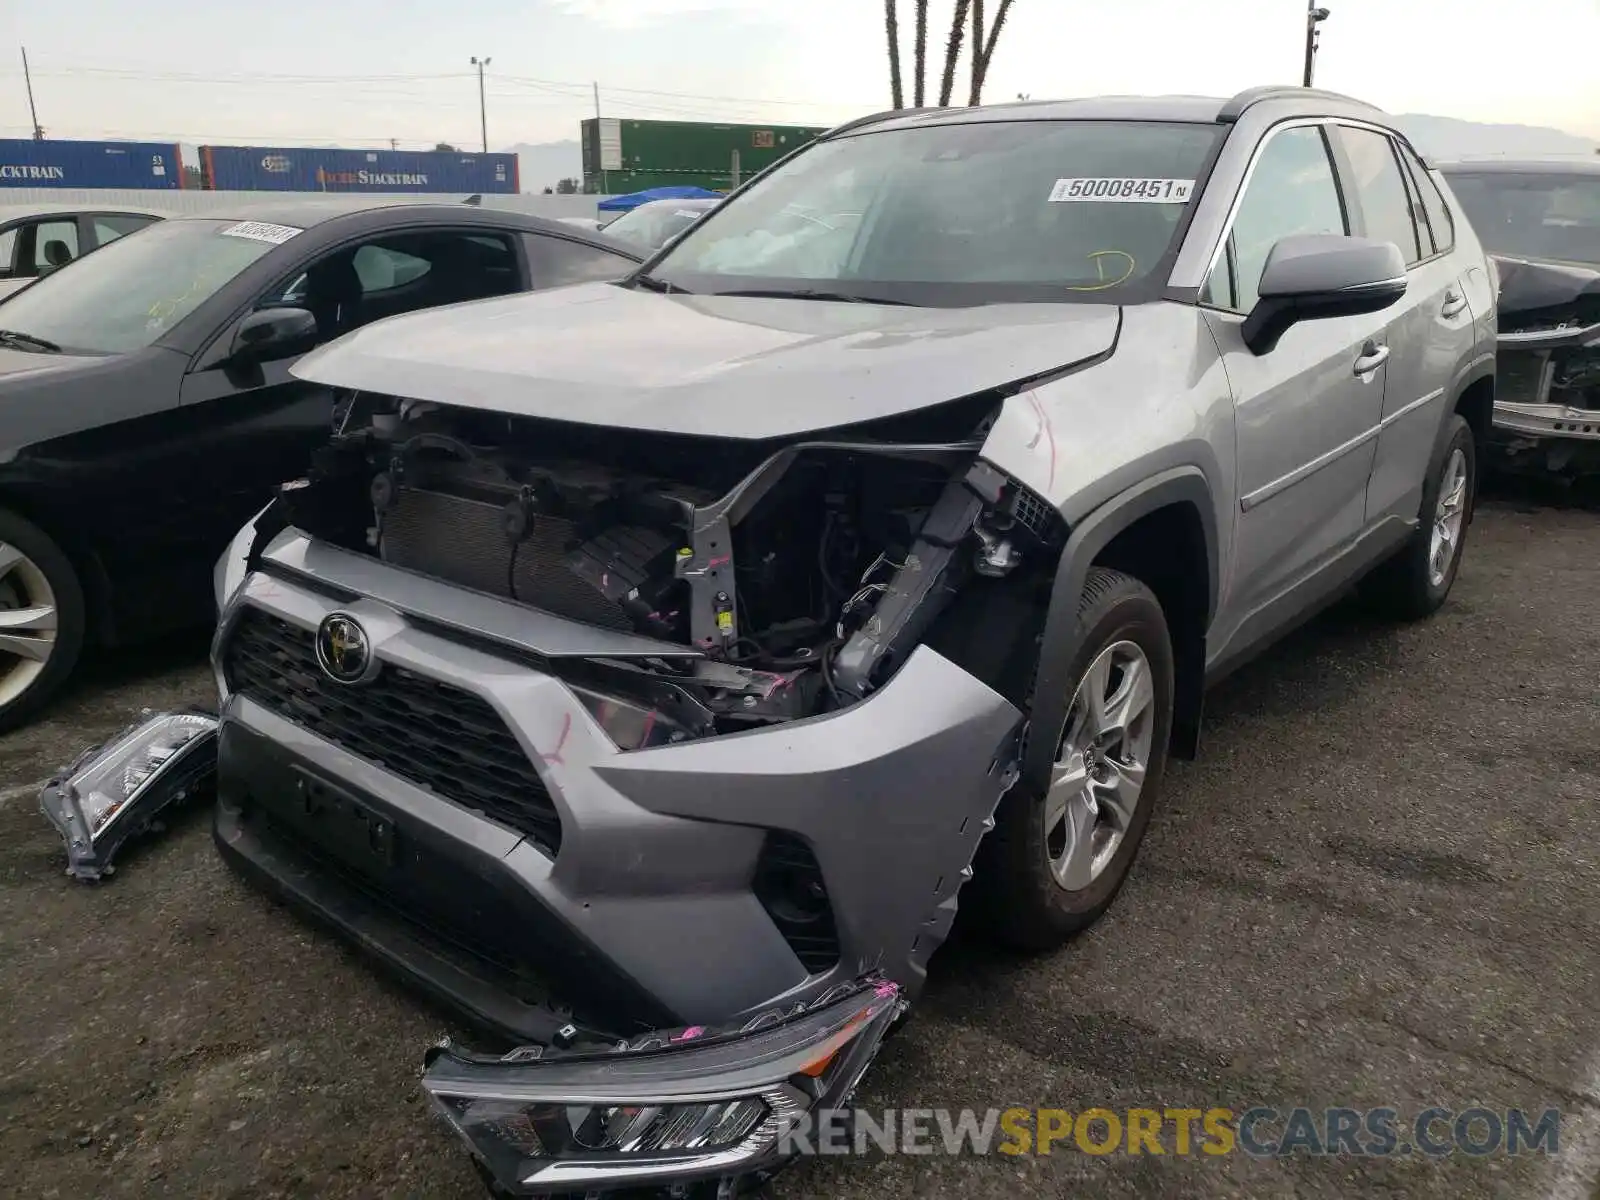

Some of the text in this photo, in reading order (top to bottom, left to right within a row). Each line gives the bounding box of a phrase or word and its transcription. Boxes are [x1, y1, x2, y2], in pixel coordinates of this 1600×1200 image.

[0, 165, 64, 179] CKTRAIN
[1068, 180, 1173, 198] 50008451
[1175, 186, 1187, 196] N
